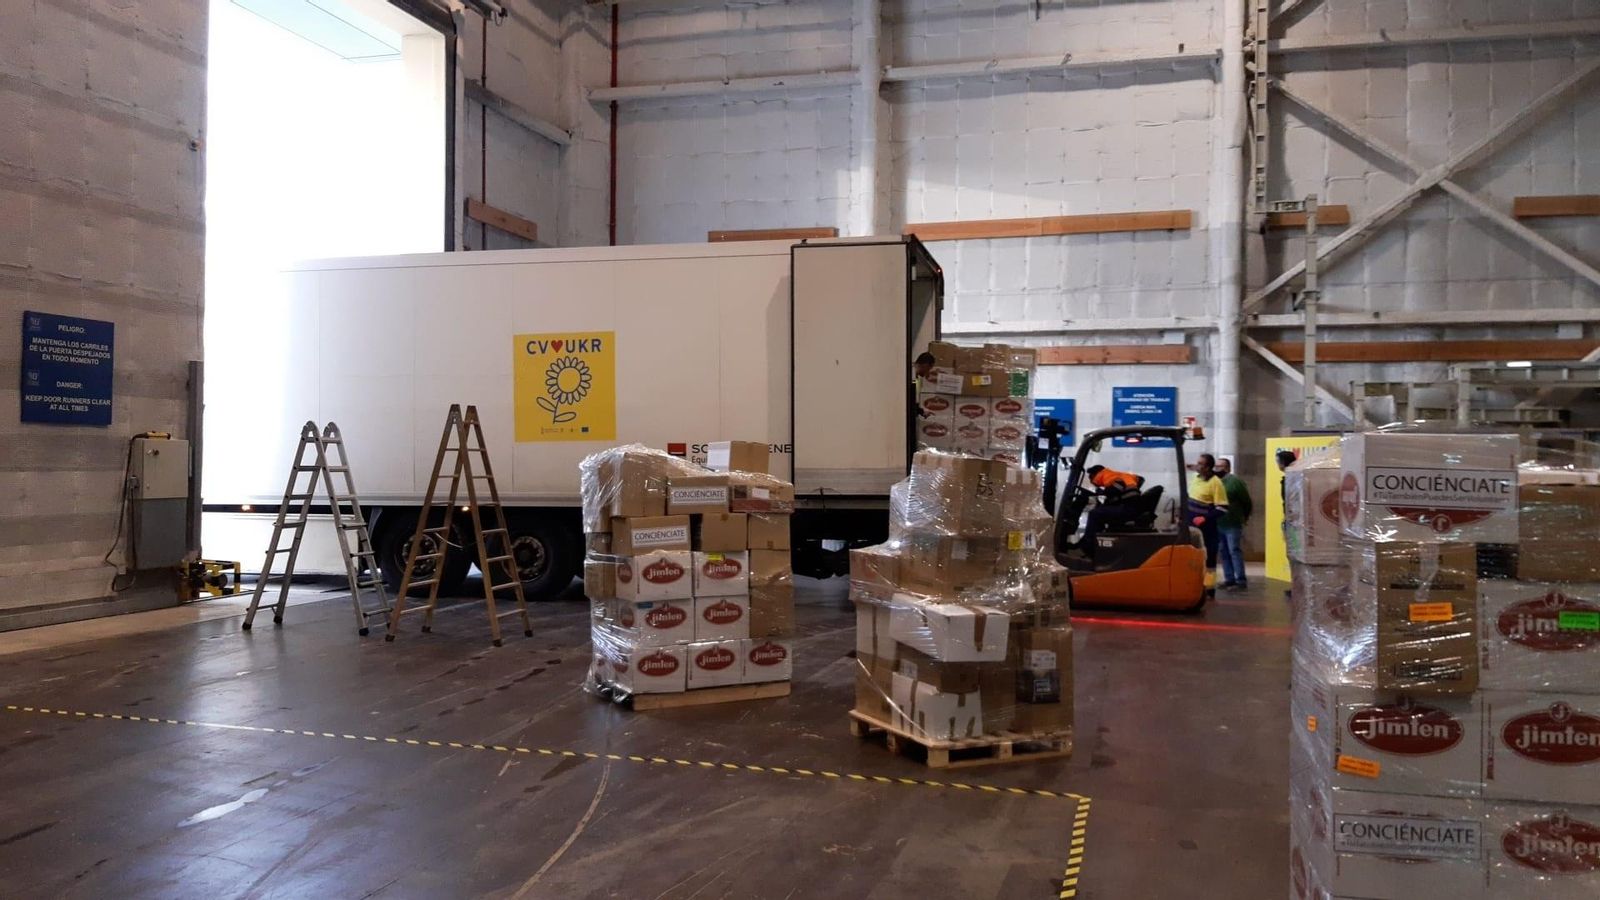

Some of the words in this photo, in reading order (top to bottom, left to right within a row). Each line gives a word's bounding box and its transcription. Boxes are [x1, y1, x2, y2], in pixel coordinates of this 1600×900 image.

[32, 337, 66, 347] MANTENGA
[80, 342, 109, 351] CARRILES
[526, 340, 549, 354] CV
[566, 338, 602, 353] UKR
[49, 347, 72, 355] PUERTA
[73, 349, 111, 359] DESPEJADOS
[70, 356, 99, 365] MOMENTO
[25, 394, 43, 402] KEEP
[43, 395, 62, 403] DOOR
[62, 397, 90, 405] RUNNERS
[691, 456, 708, 464] Equi
[1372, 474, 1510, 494] CONCIÉNCIATE
[1362, 716, 1449, 739] jimten
[1340, 821, 1475, 845] CONCIÉNCIATE
